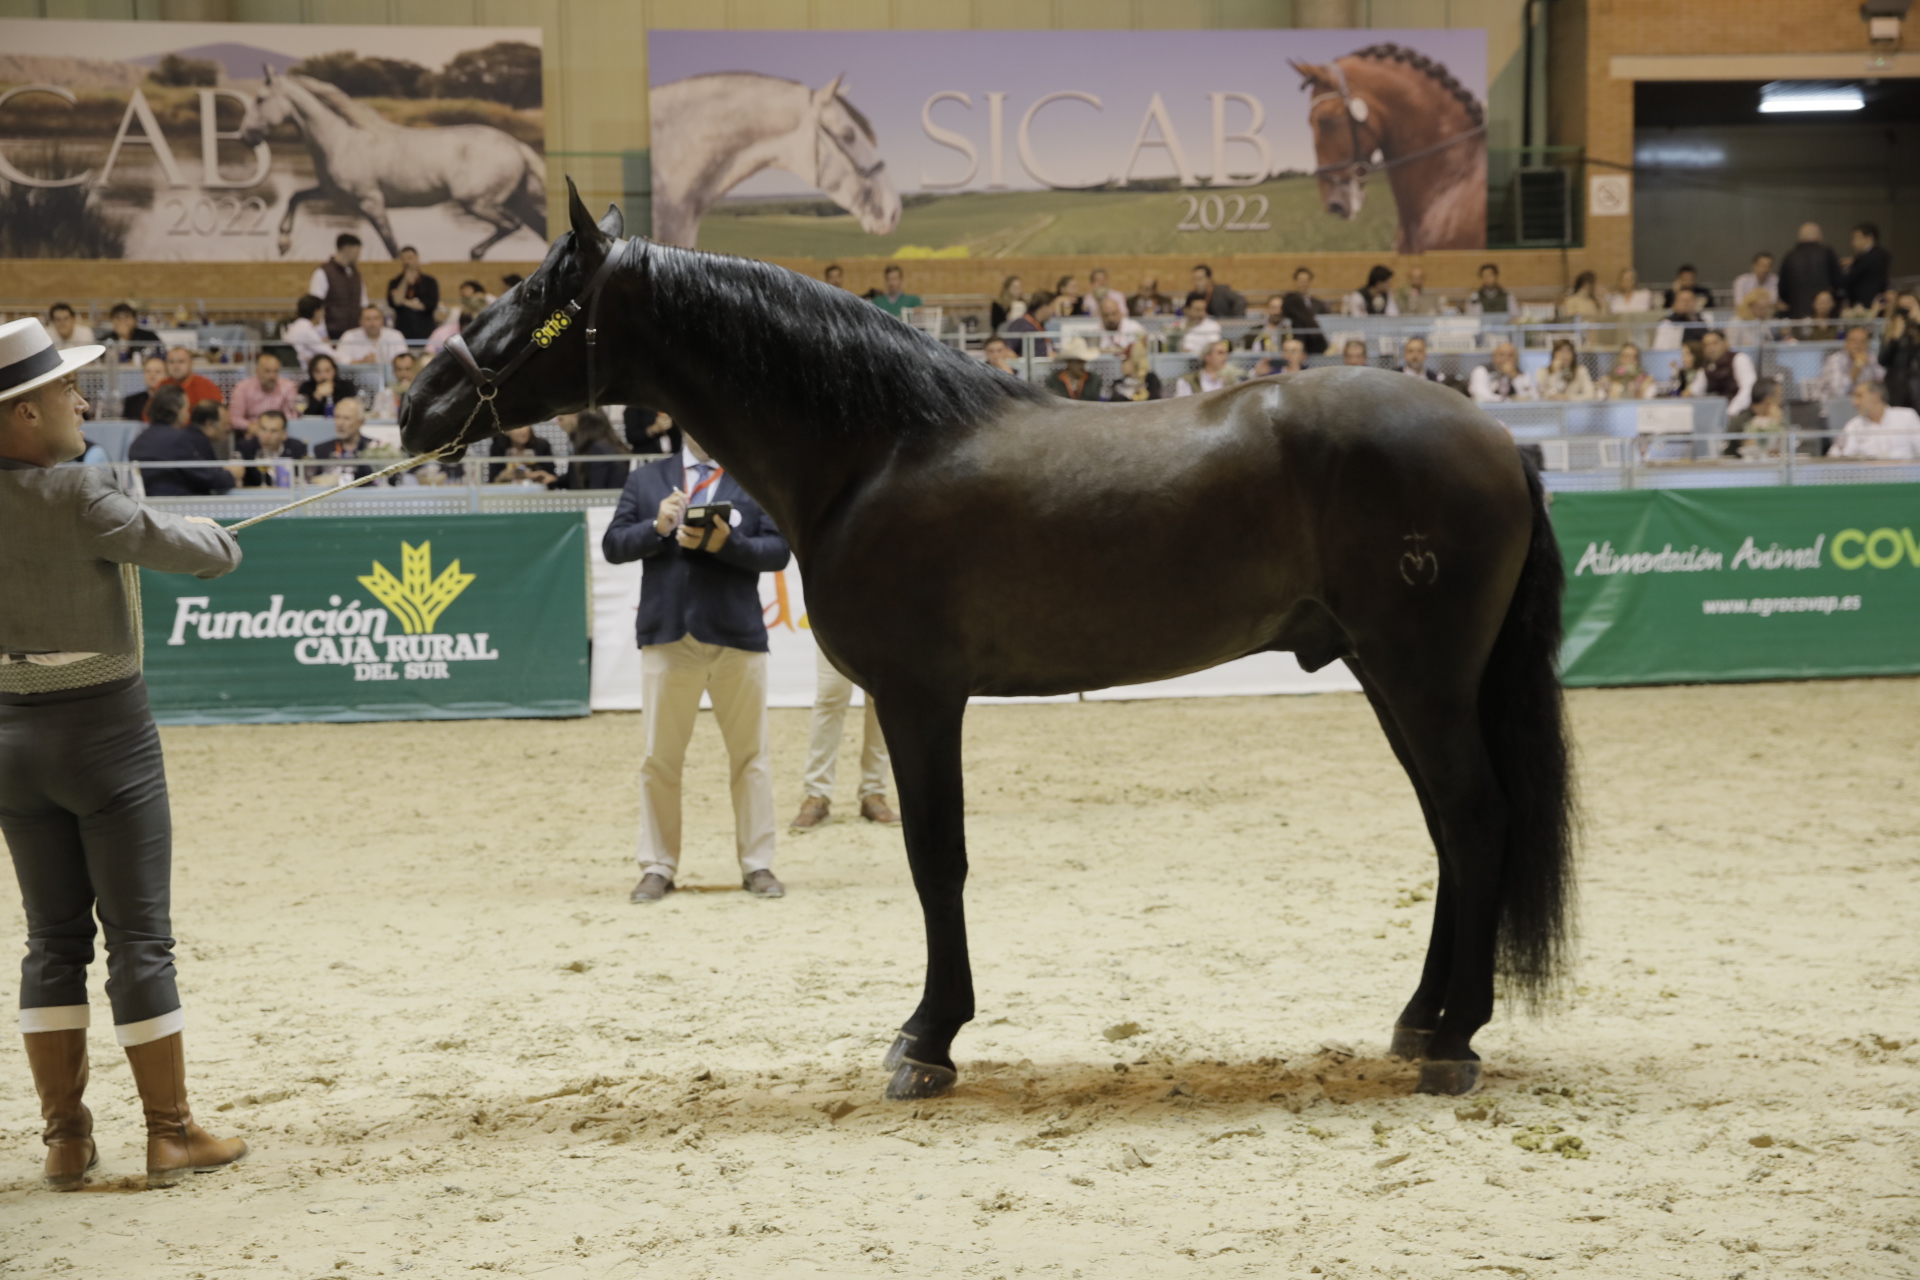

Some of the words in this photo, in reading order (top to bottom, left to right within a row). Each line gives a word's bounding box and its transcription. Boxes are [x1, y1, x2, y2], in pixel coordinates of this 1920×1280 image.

[919, 90, 1274, 190] SICAB
[166, 197, 271, 237] 2022
[1175, 193, 1272, 232] 2022
[1730, 533, 1826, 571] Animal
[168, 594, 389, 646] Fundación
[294, 636, 380, 666] CAJA
[385, 633, 499, 662] RURAL
[354, 662, 399, 681] DEL
[404, 661, 450, 680] SUR
